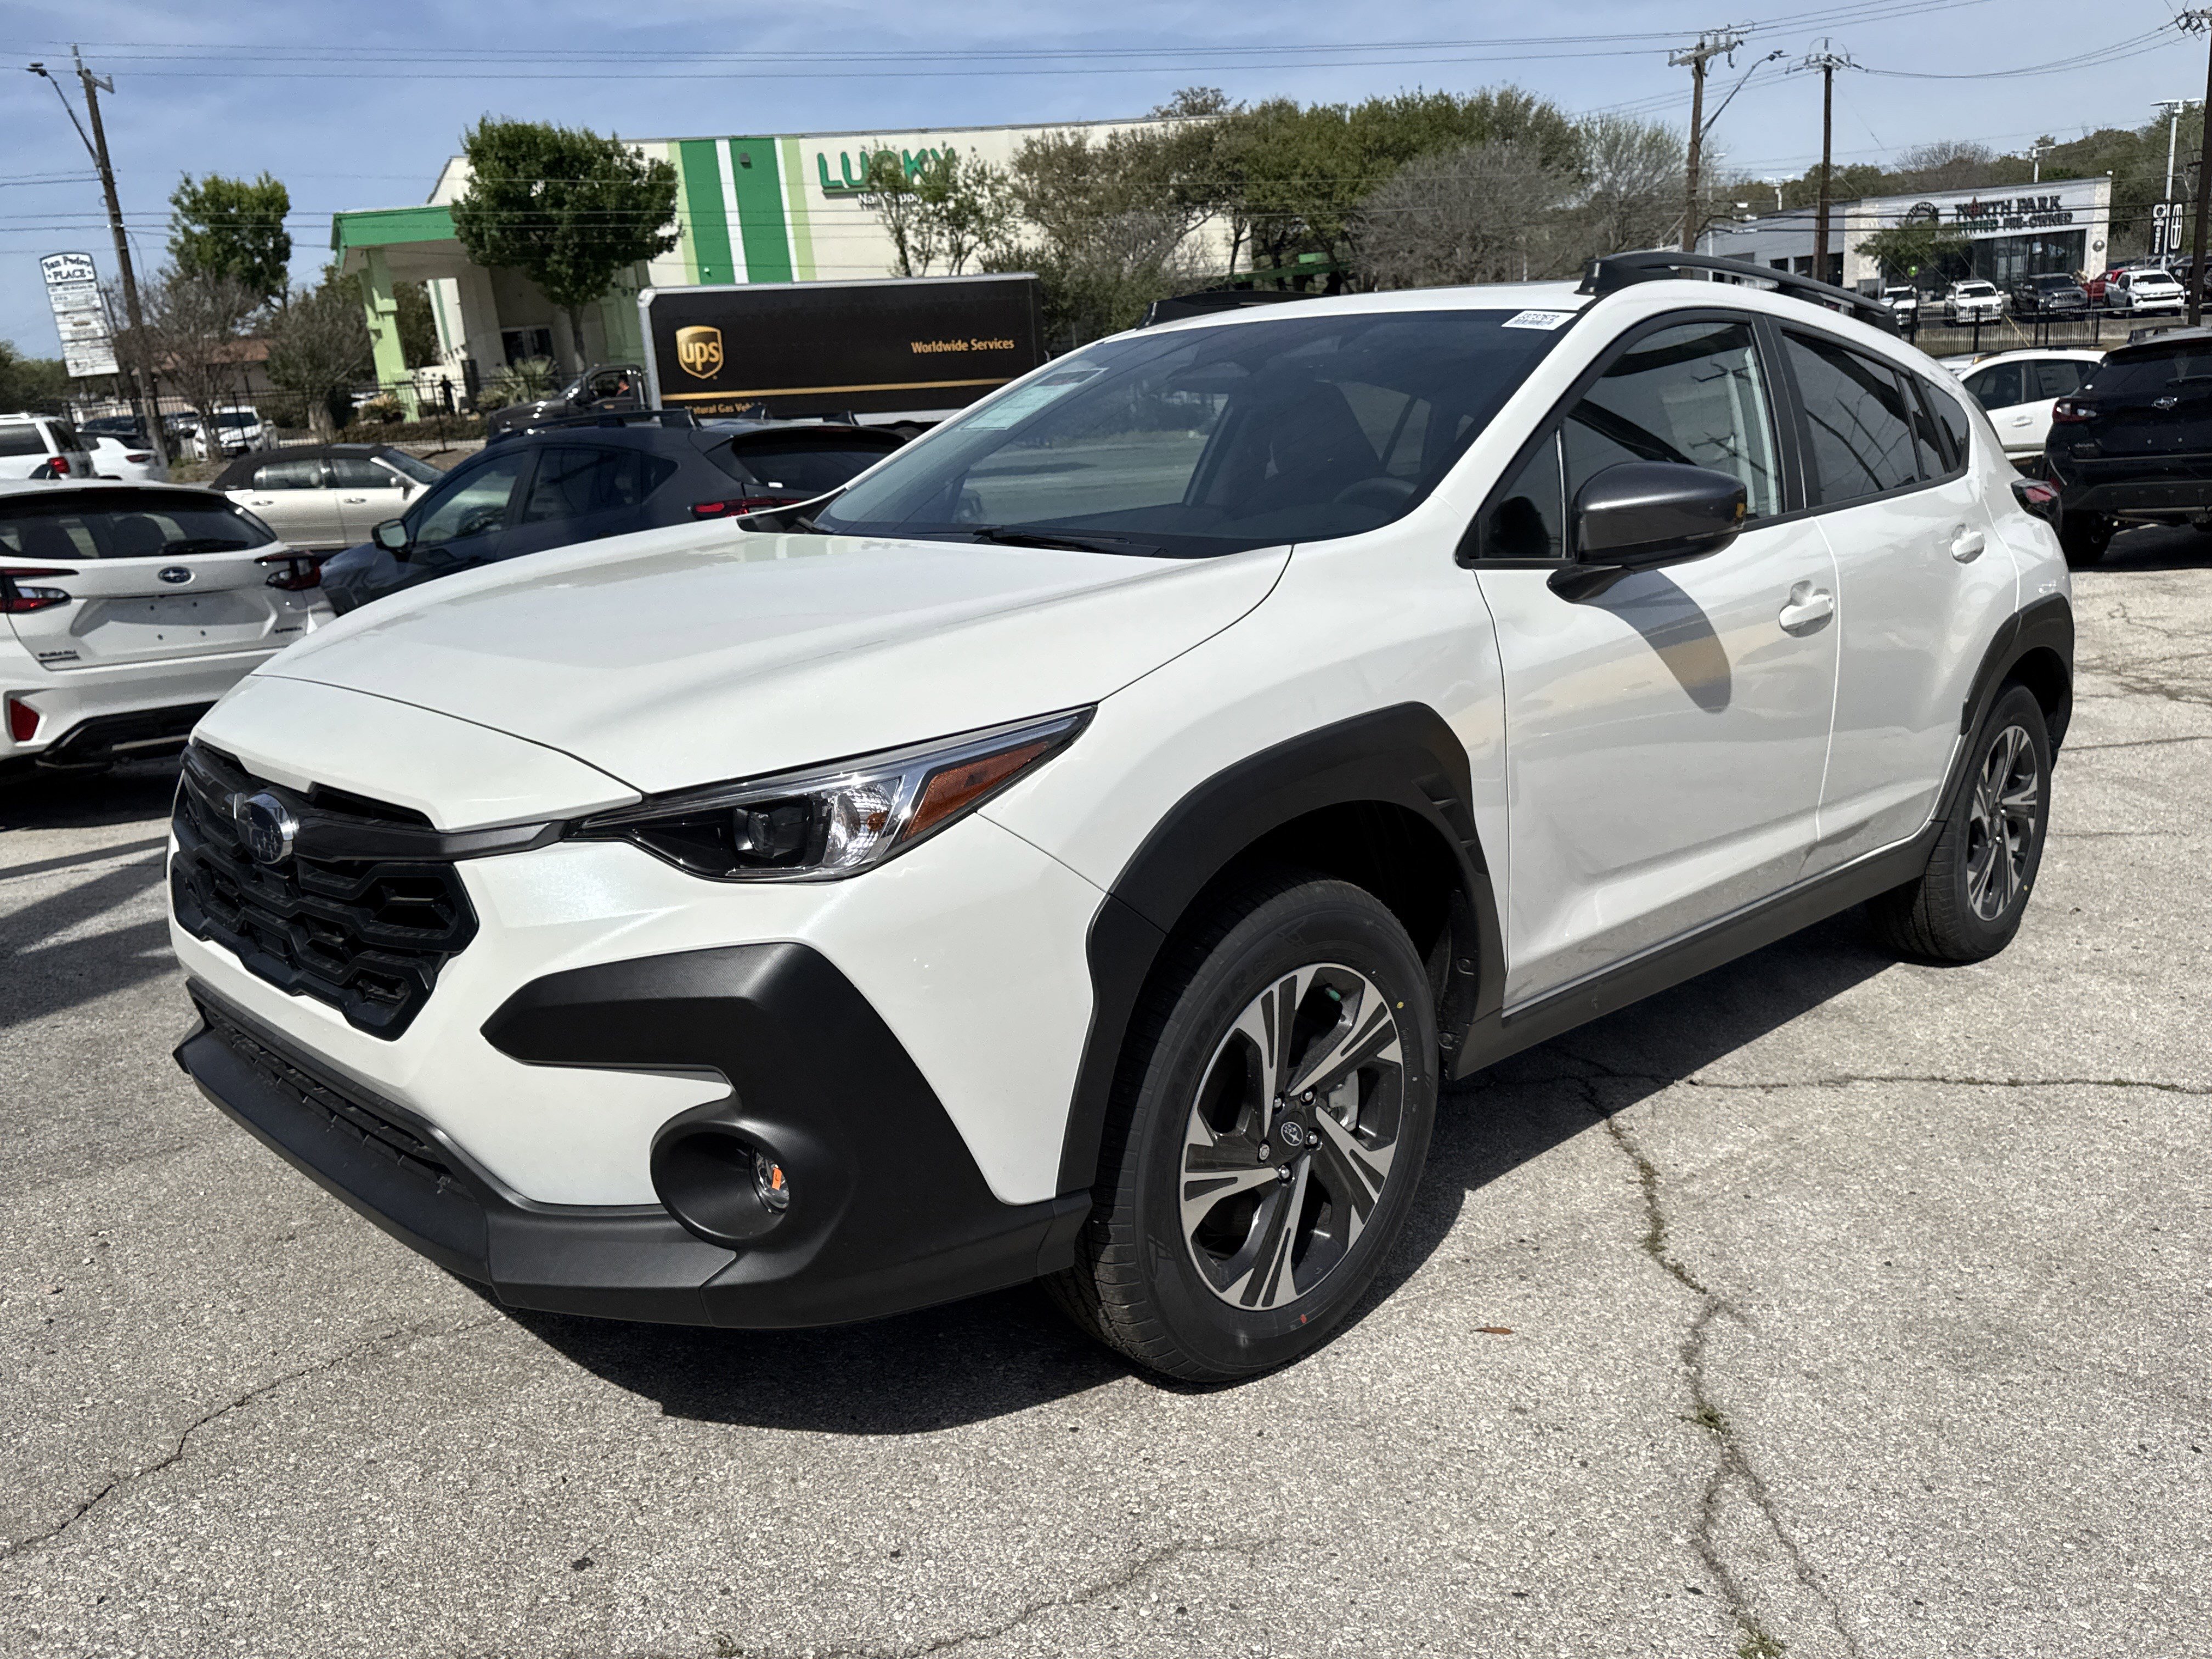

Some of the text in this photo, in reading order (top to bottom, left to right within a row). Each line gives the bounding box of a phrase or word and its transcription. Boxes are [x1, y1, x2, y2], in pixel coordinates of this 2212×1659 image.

[2017, 195, 2062, 212] PARK
[53, 268, 86, 280] PLACE
[911, 337, 1015, 354] Worldwide Services
[681, 341, 720, 371] ups
[717, 403, 734, 413] Gas
